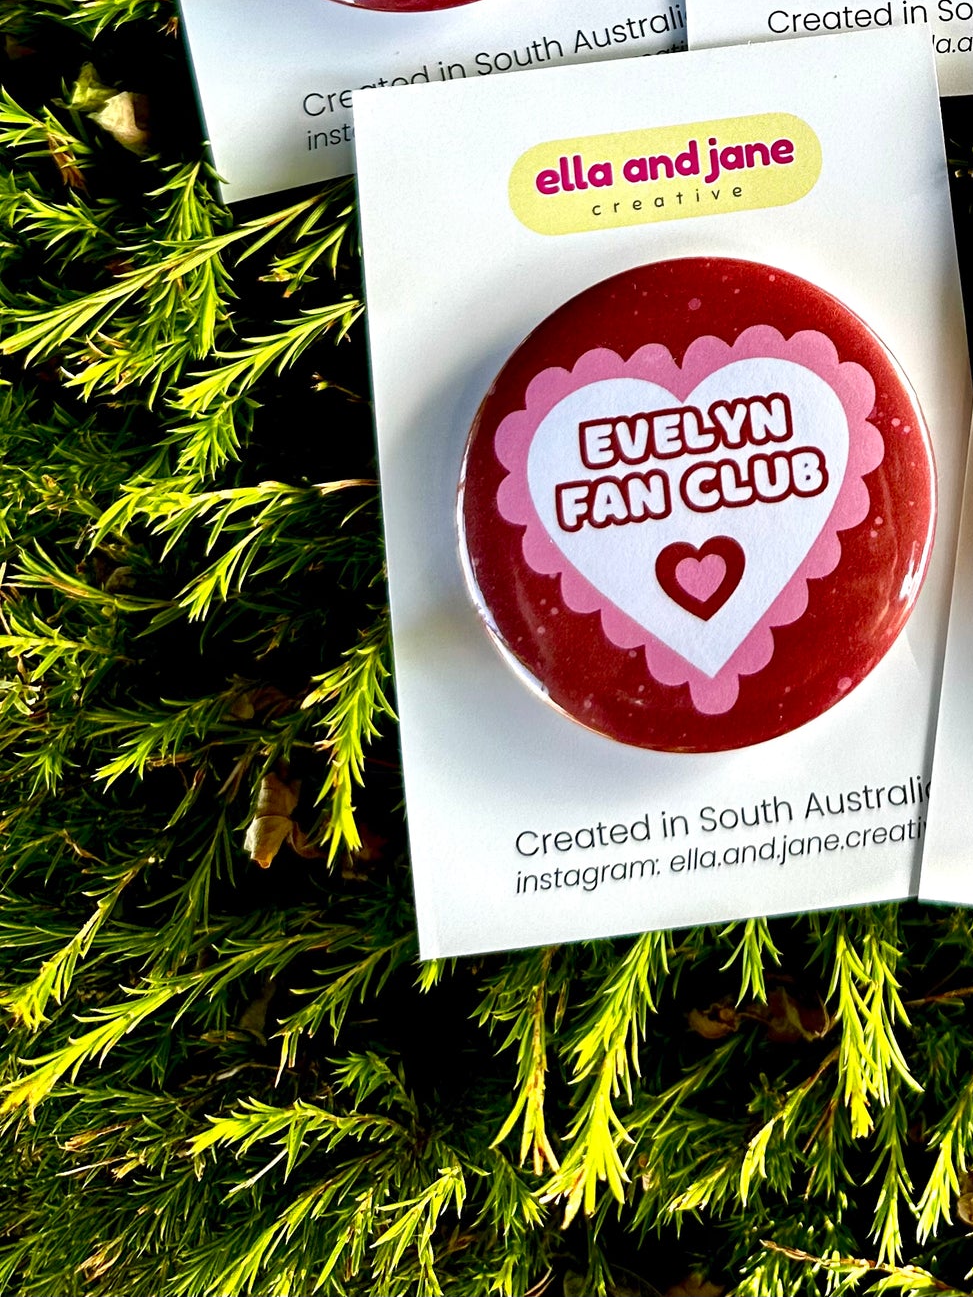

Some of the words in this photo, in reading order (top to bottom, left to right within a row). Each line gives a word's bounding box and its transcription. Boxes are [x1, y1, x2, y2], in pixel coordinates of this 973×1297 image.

[767, 1, 893, 34] Created
[902, 0, 928, 25] in
[302, 64, 431, 117] Cretd
[438, 59, 467, 83] in
[474, 35, 566, 77] South
[573, 3, 687, 54] Australi
[307, 122, 355, 151] inst
[534, 154, 614, 196] ella
[622, 139, 701, 184] and
[703, 137, 796, 185] jane
[590, 184, 744, 218] creative
[578, 392, 795, 470] EVELYN
[554, 469, 672, 534] FAN
[679, 446, 830, 513] CLUB
[514, 813, 652, 859] Created
[660, 809, 690, 840] in
[699, 795, 795, 834] South
[803, 774, 932, 821] Australi
[514, 857, 663, 896] instagram:
[668, 815, 929, 874] ella.and.jane.creati
